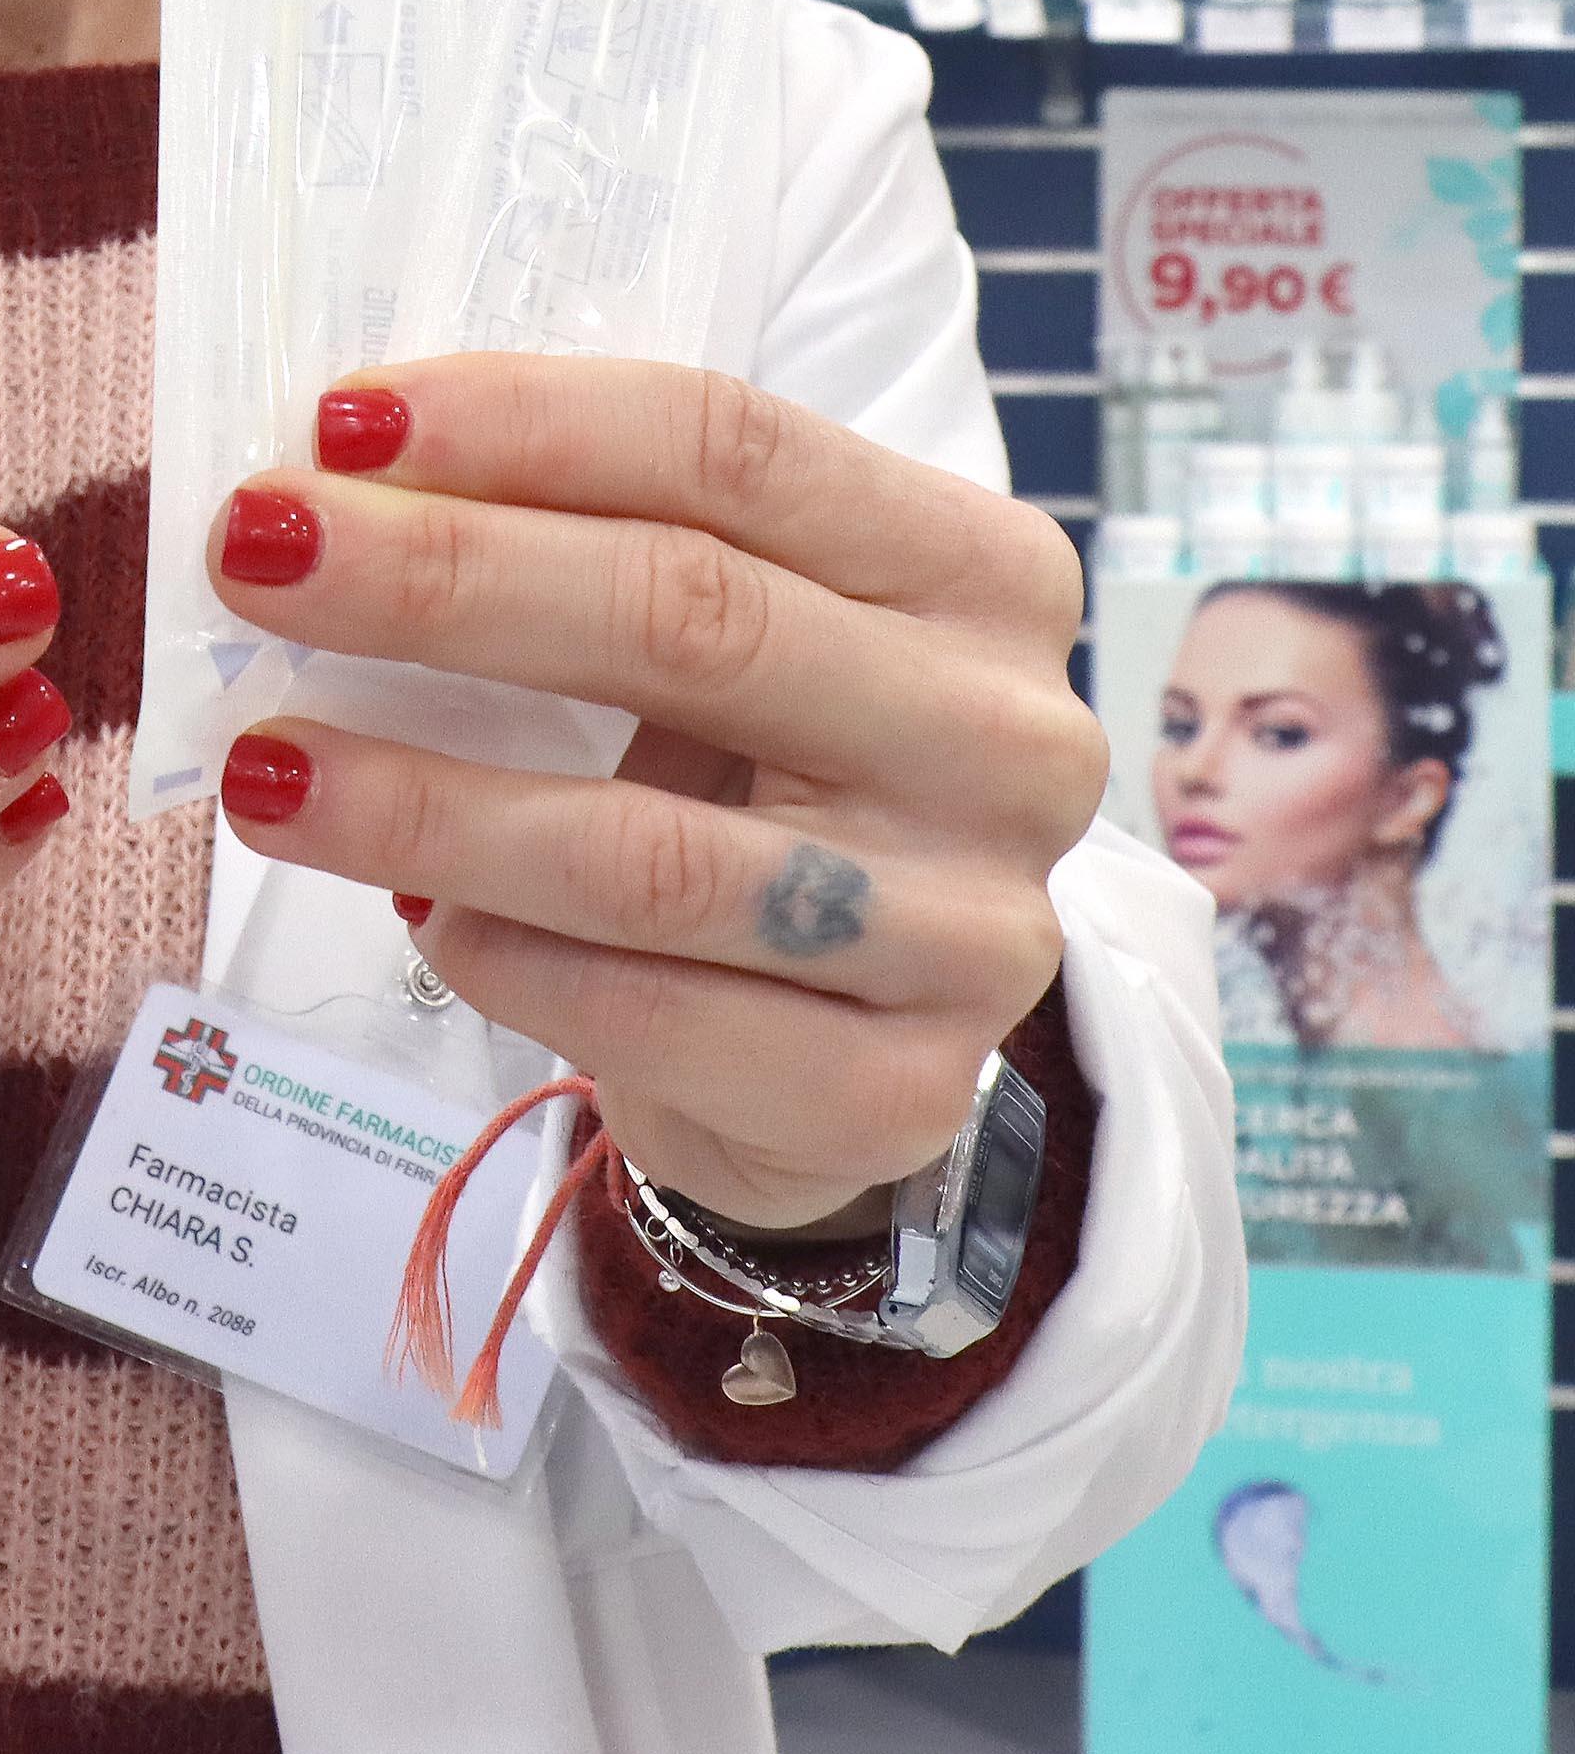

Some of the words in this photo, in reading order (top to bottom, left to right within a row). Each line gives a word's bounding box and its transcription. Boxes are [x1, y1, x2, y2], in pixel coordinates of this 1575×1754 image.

[1151, 187, 1324, 212] OFFERTA
[1151, 219, 1325, 248] SPECIALE
[1150, 250, 1305, 324] 9,90
[1319, 261, 1357, 316] €
[233, 1090, 283, 1122] DELLA
[286, 1113, 371, 1158] PROVINCIA
[373, 1149, 393, 1167] DI
[395, 1157, 440, 1187] FERR
[243, 1063, 332, 1115] ORDINE
[336, 1101, 464, 1166] FARMACIS
[110, 1187, 223, 1254] CHIARA
[230, 1236, 254, 1268] S.
[128, 1144, 298, 1234] Farmacista
[85, 1254, 126, 1286] Iscr.
[132, 1276, 180, 1306] Albo
[184, 1297, 200, 1317] n.
[207, 1305, 257, 1336] 2088
